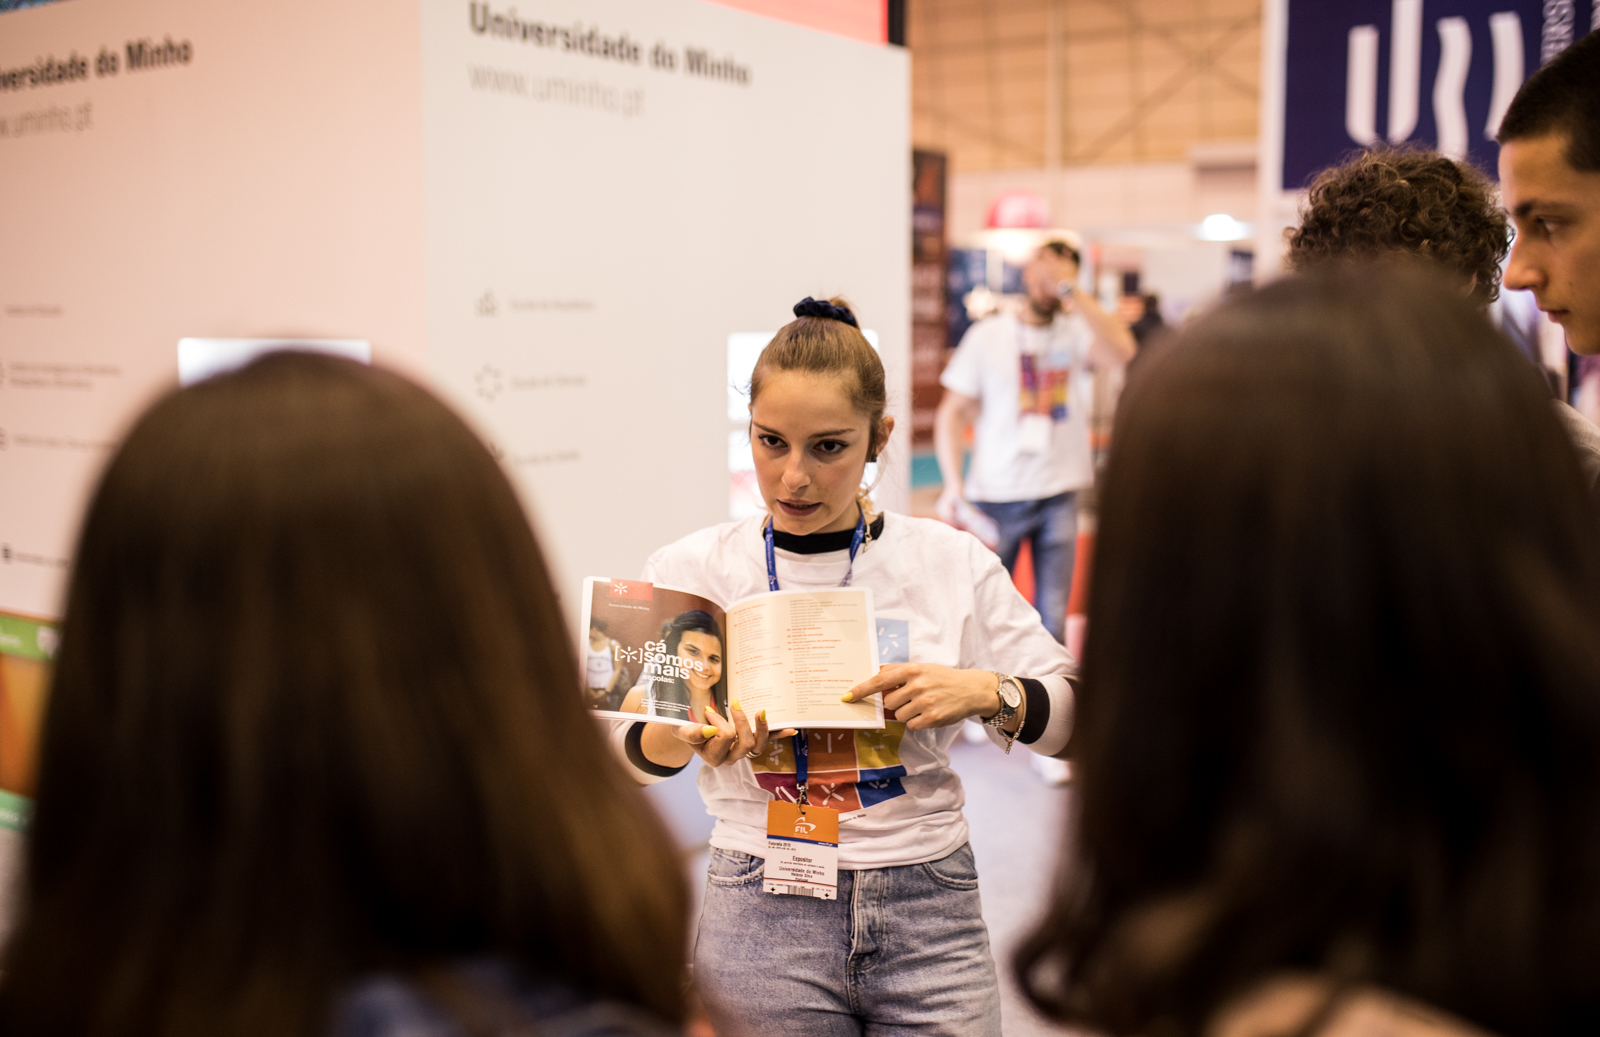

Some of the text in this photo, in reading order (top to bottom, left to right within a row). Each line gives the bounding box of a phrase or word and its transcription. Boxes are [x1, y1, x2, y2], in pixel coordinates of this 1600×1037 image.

[469, 0, 752, 85] Universidade do Minho
[97, 47, 118, 77] do
[126, 37, 191, 72] Minho
[469, 66, 645, 116] www.uminho.pt
[644, 639, 666, 653] cá
[643, 651, 703, 672] somos
[643, 662, 690, 680] mais
[642, 674, 674, 684] escolas:
[794, 826, 808, 834] FIL
